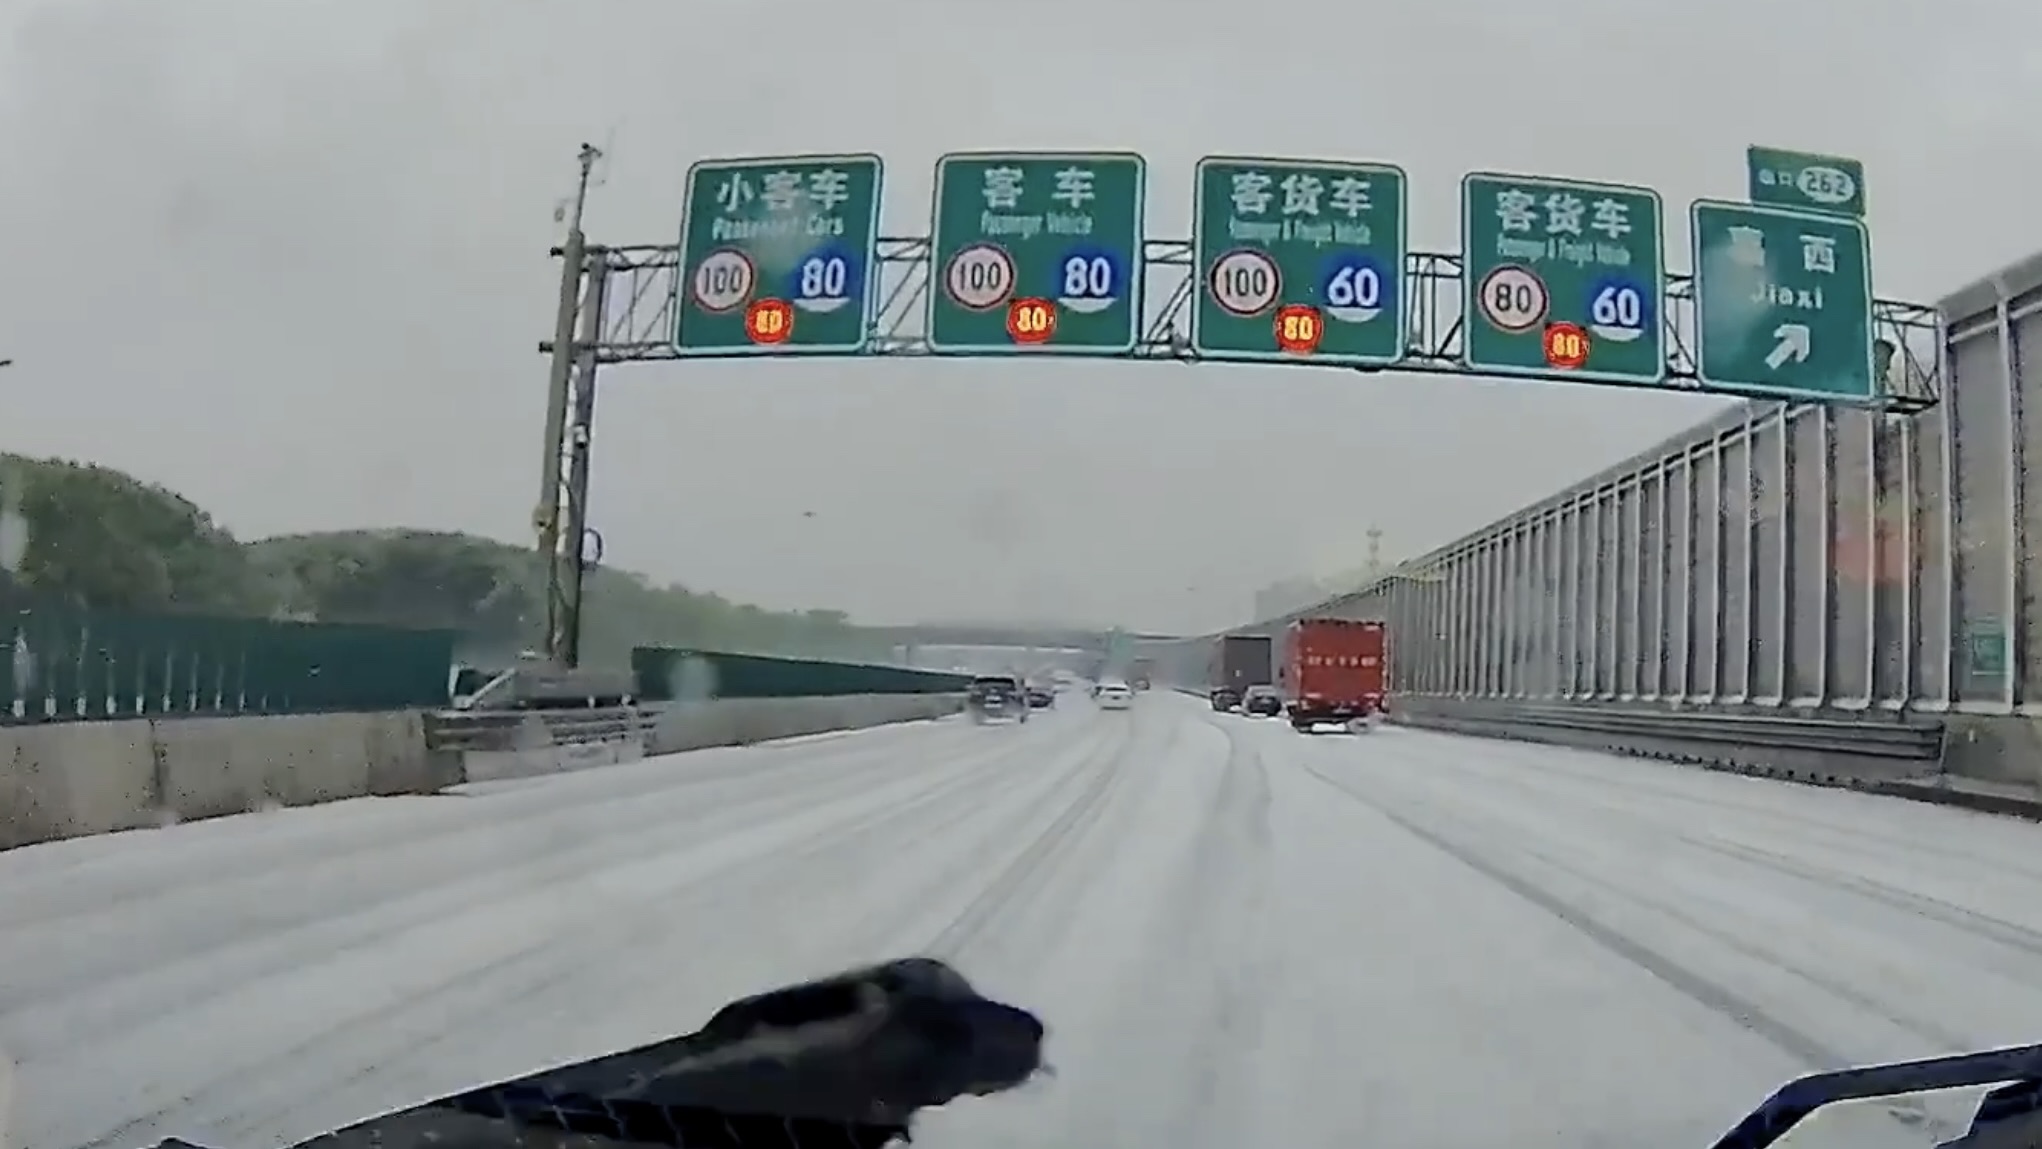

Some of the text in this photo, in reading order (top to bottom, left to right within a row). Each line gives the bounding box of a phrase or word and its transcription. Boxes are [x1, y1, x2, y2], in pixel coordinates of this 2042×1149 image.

[716, 168, 849, 212] 小客车
[981, 166, 1096, 209] 客车
[1230, 171, 1374, 218] 客货车
[1804, 170, 1847, 197] 262
[1496, 188, 1632, 239] 客货车
[703, 265, 744, 294] 100
[802, 257, 847, 297] 80
[959, 261, 1002, 292] 100
[1065, 256, 1112, 297] 80
[1224, 267, 1269, 297] 100
[1328, 266, 1380, 307] 60
[1495, 283, 1532, 314] 80
[1592, 285, 1641, 326] 60
[1753, 282, 1823, 309] Jiaxi
[755, 309, 784, 335] 80
[1016, 306, 1047, 332] 80
[1283, 315, 1314, 341] 80
[1551, 332, 1581, 358] 80
